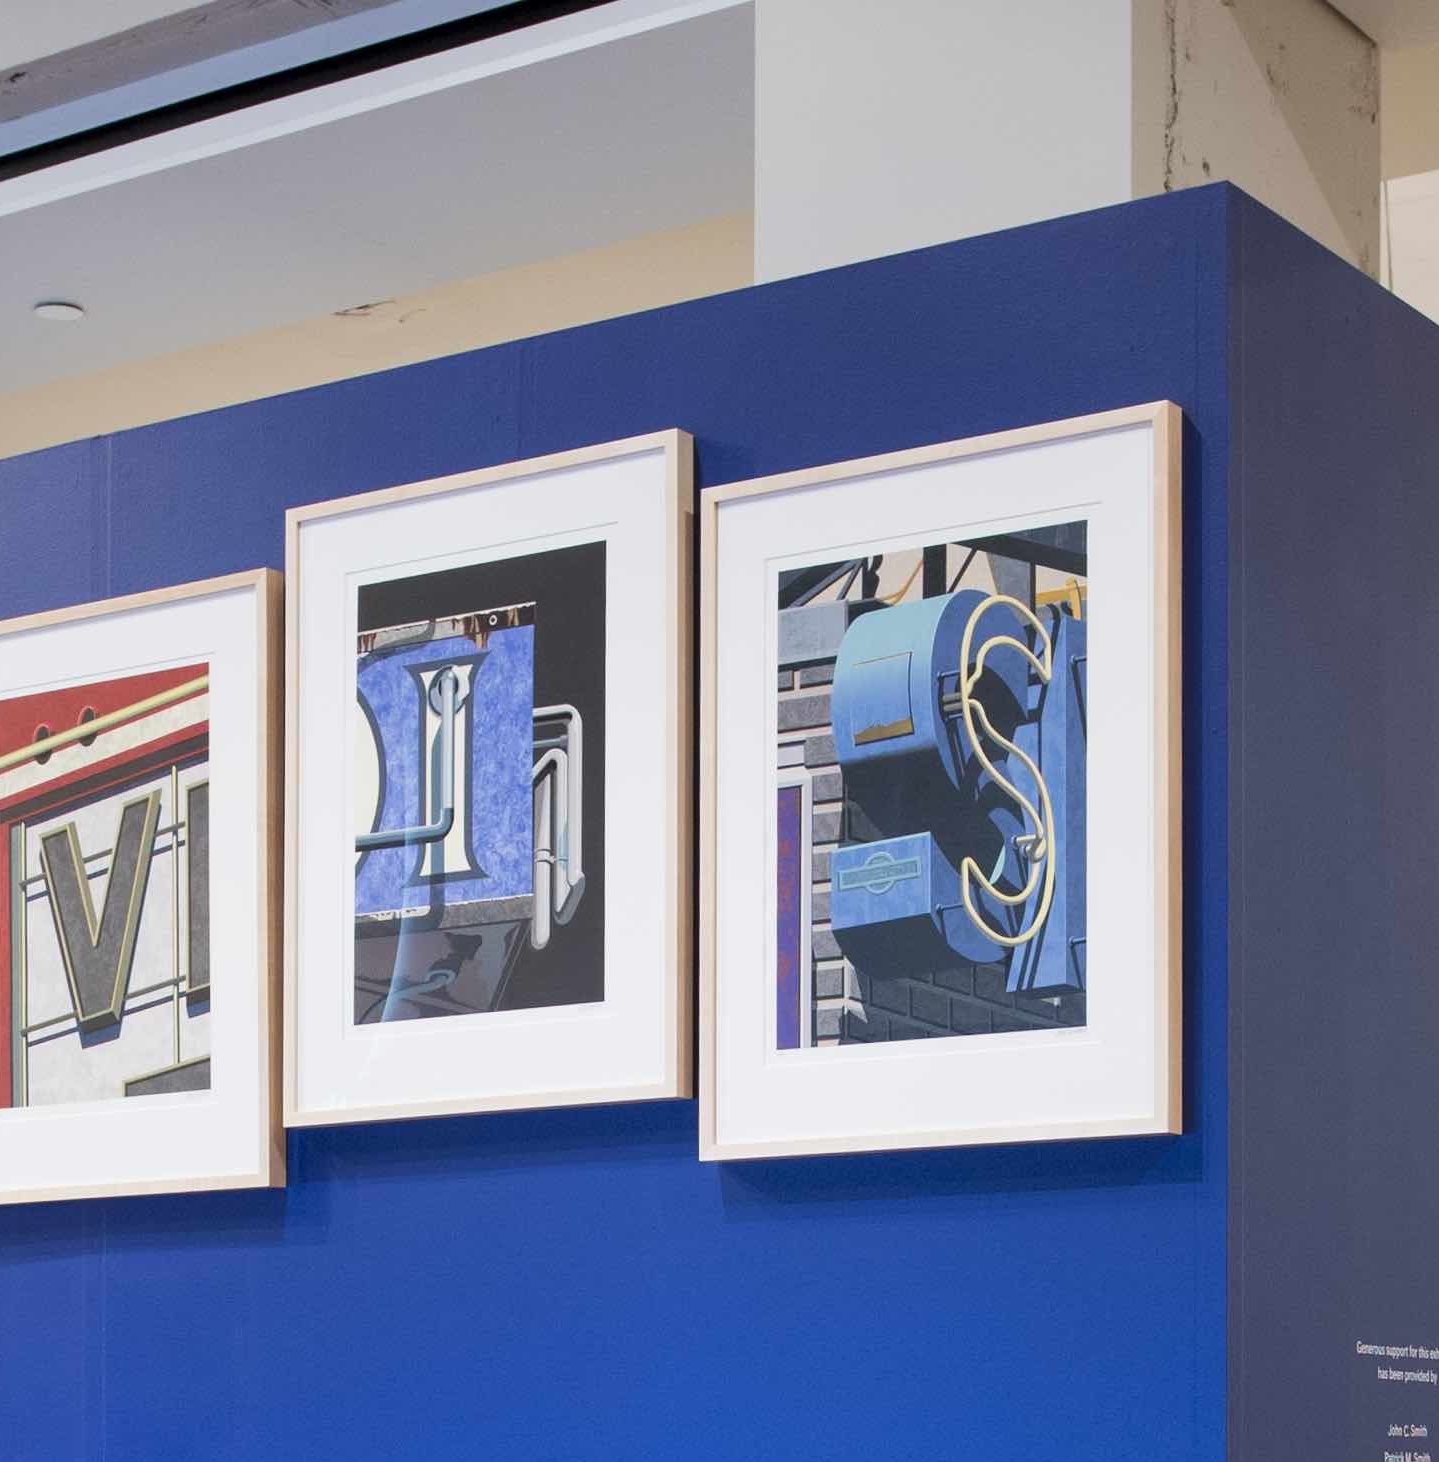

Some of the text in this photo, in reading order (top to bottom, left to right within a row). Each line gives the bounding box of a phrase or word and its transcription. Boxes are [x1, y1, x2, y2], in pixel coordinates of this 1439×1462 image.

[1356, 1341, 1385, 1355] Generous
[1386, 1346, 1408, 1359] support
[1410, 1345, 1418, 1358] for
[1418, 1346, 1429, 1359] this
[1378, 1366, 1438, 1385] has been provided by
[1387, 1424, 1402, 1436] John
[1411, 1424, 1428, 1437] Smith
